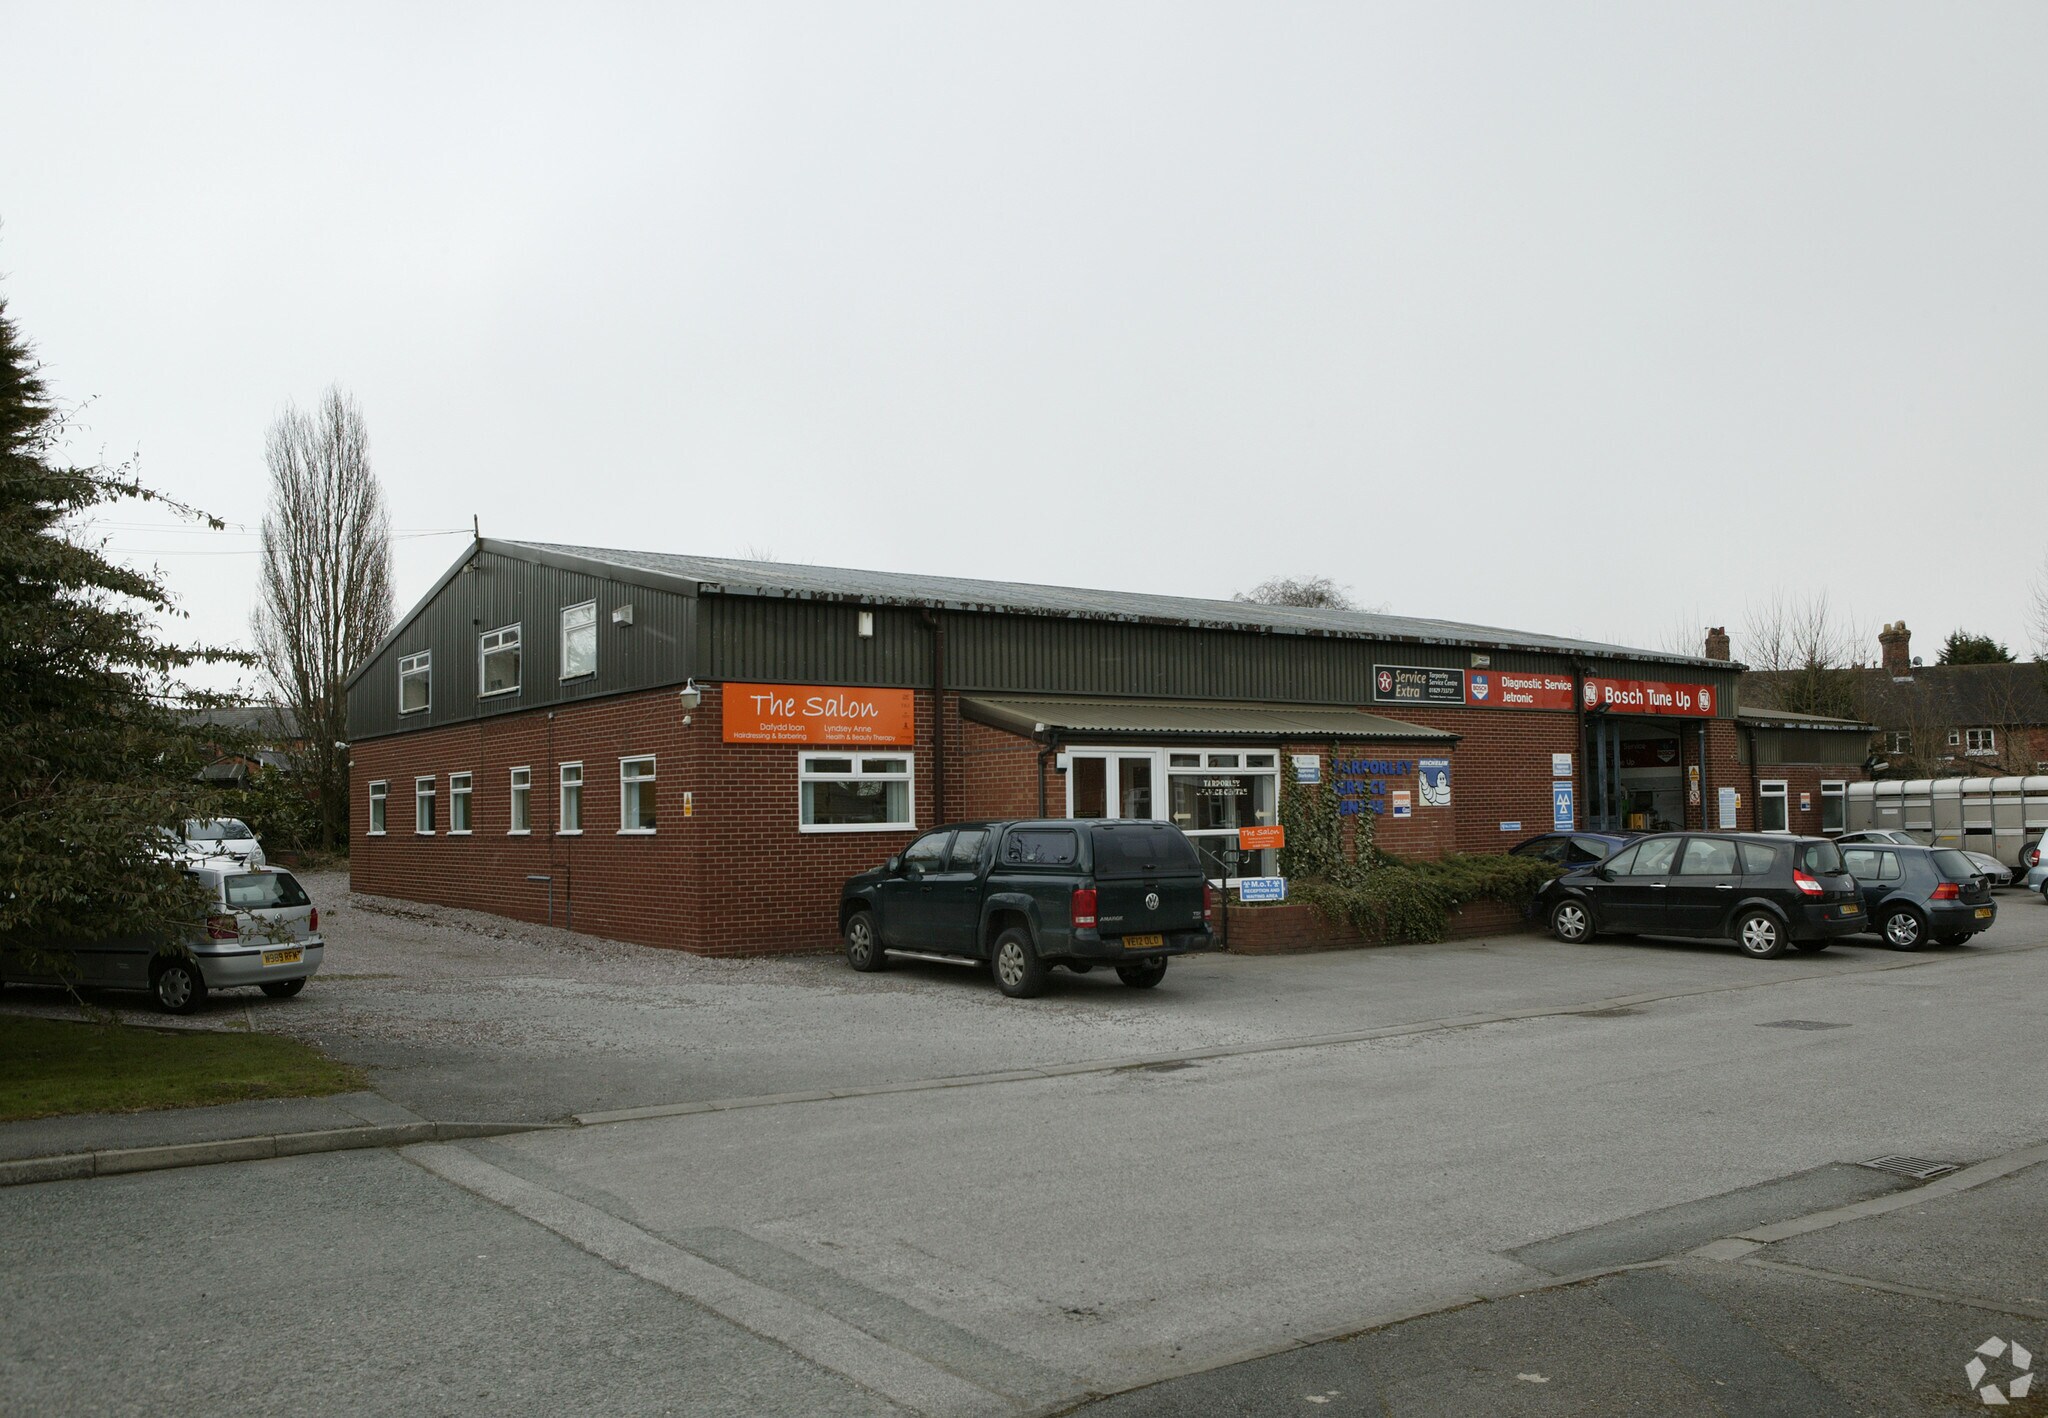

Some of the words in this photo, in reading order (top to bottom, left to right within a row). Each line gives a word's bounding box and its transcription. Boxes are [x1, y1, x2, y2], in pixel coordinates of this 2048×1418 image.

[1395, 670, 1427, 684] Service
[1501, 676, 1542, 690] Diagnostic
[1545, 679, 1572, 691] Service
[1396, 685, 1420, 698] Extra
[1503, 692, 1534, 703] Jetronic
[750, 691, 796, 717] The
[802, 694, 879, 718] Salon
[1605, 686, 1643, 705] Bosch
[1647, 689, 1672, 706] Tune
[1676, 691, 1691, 711] Up
[760, 722, 788, 732] Dafydd
[824, 724, 851, 733] Lyndsey
[853, 725, 872, 733] Anne
[733, 731, 771, 740] Hairdressing
[778, 732, 807, 741] Barbering
[873, 734, 896, 742] Therapy
[1333, 759, 1412, 775] TARPORLEY
[1333, 779, 1386, 795] ERVCE
